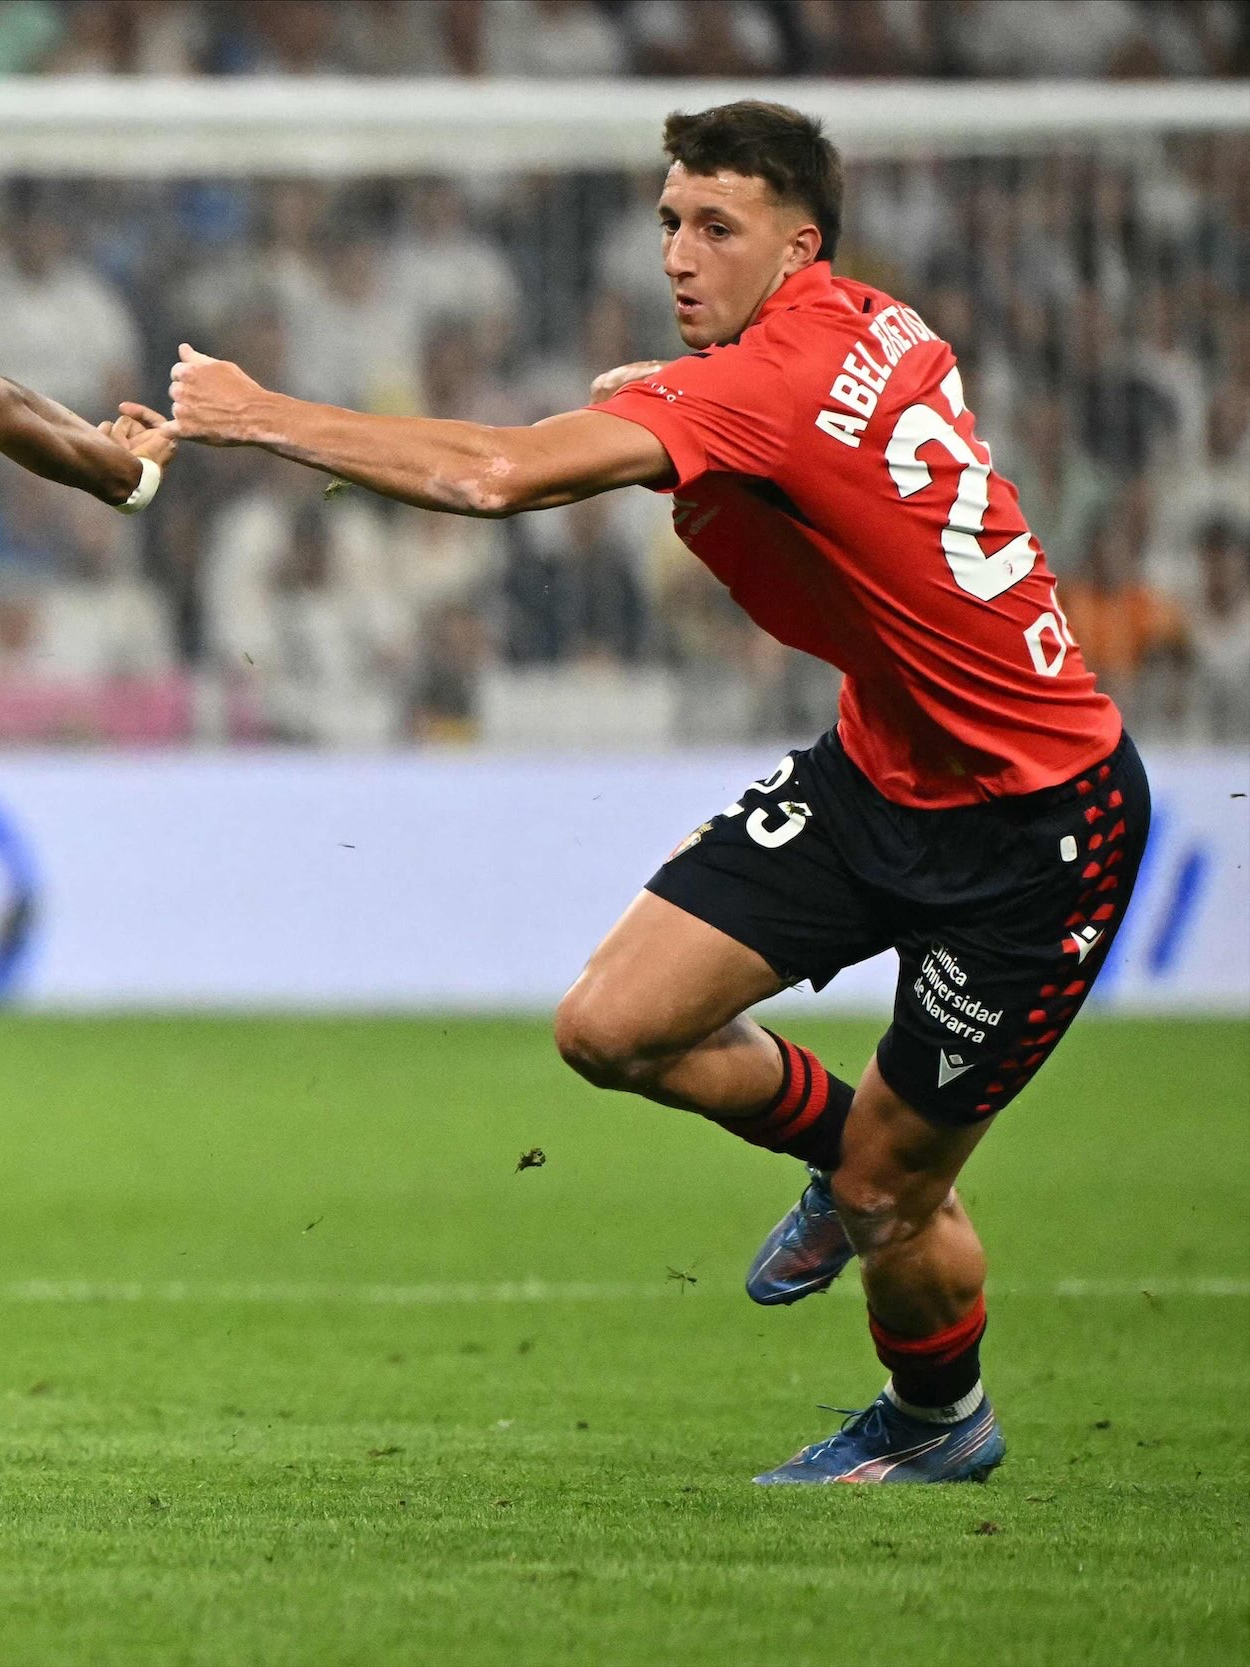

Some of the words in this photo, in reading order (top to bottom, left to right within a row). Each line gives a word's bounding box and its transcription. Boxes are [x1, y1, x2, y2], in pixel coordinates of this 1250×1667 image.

[814, 341, 892, 448] ABEL
[868, 304, 946, 367] BRETO
[886, 366, 1038, 602] 2
[921, 954, 1004, 1026] Universidad
[922, 990, 986, 1043] Navarra
